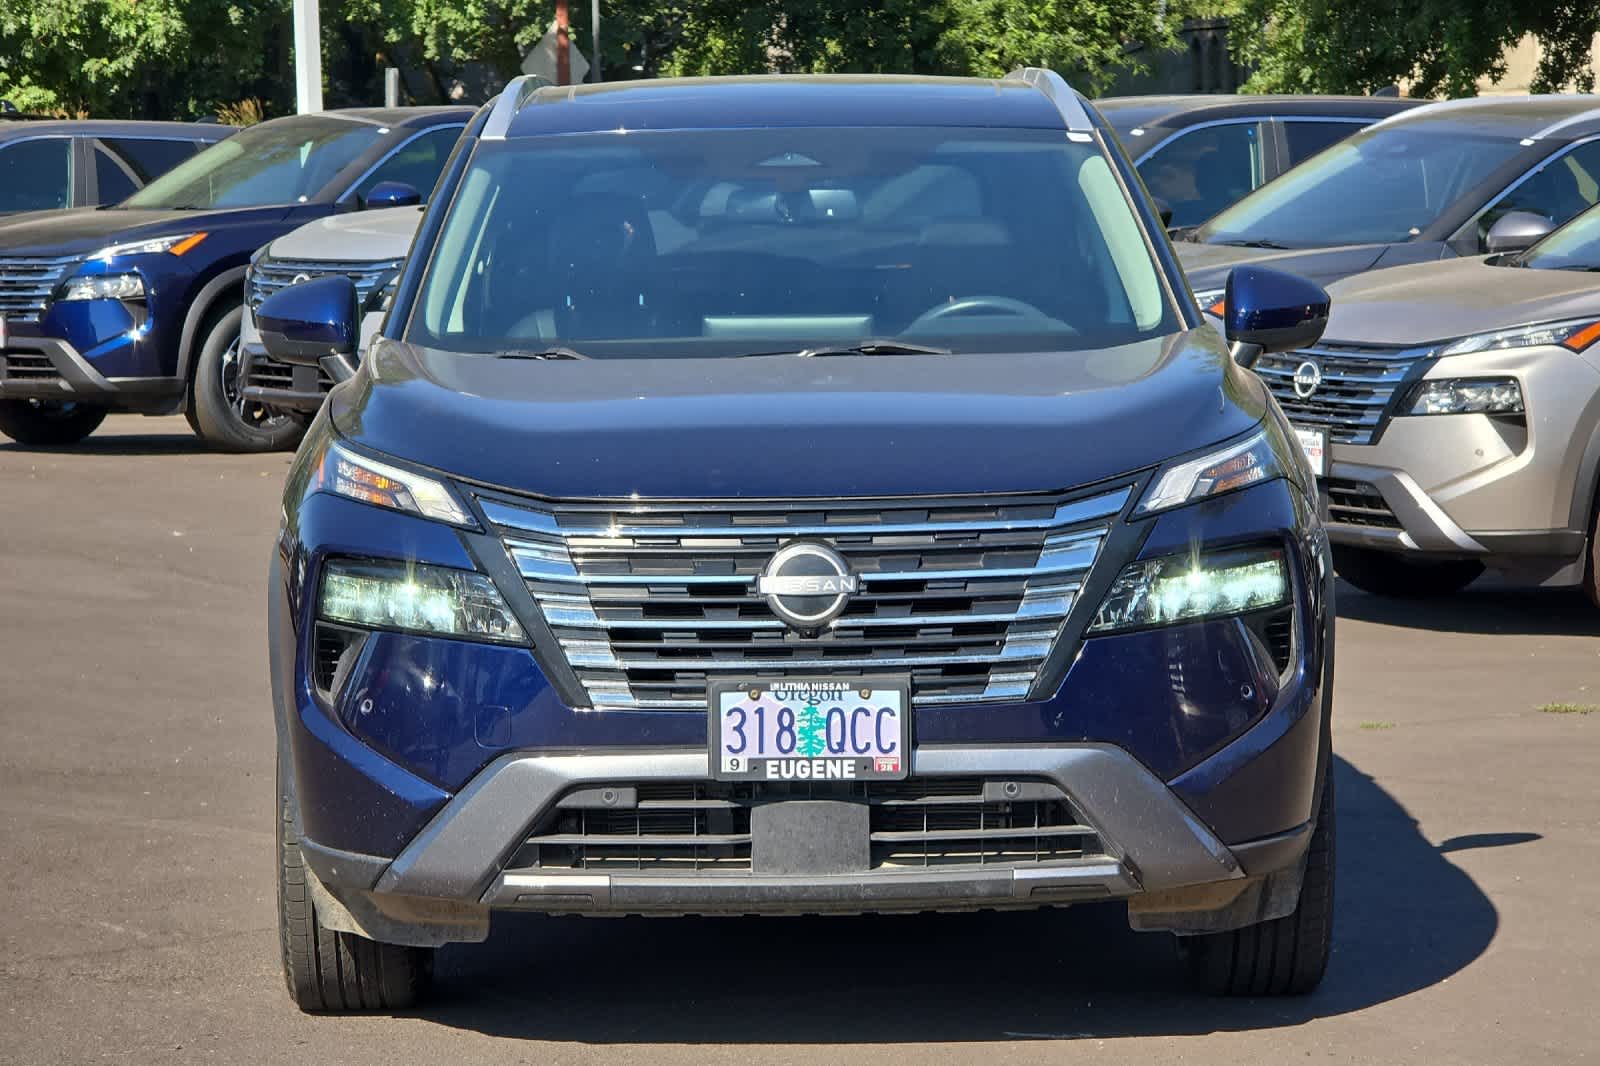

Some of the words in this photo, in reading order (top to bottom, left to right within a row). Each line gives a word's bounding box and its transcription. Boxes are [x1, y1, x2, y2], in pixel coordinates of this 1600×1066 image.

[762, 577, 854, 591] SSAN
[780, 682, 810, 691] LITHIA
[811, 682, 850, 690] NISSAN
[775, 689, 843, 705] Oregon
[726, 707, 797, 754] 318
[825, 707, 897, 754] QCC
[730, 759, 740, 770] 9
[766, 760, 856, 779] EUGENE
